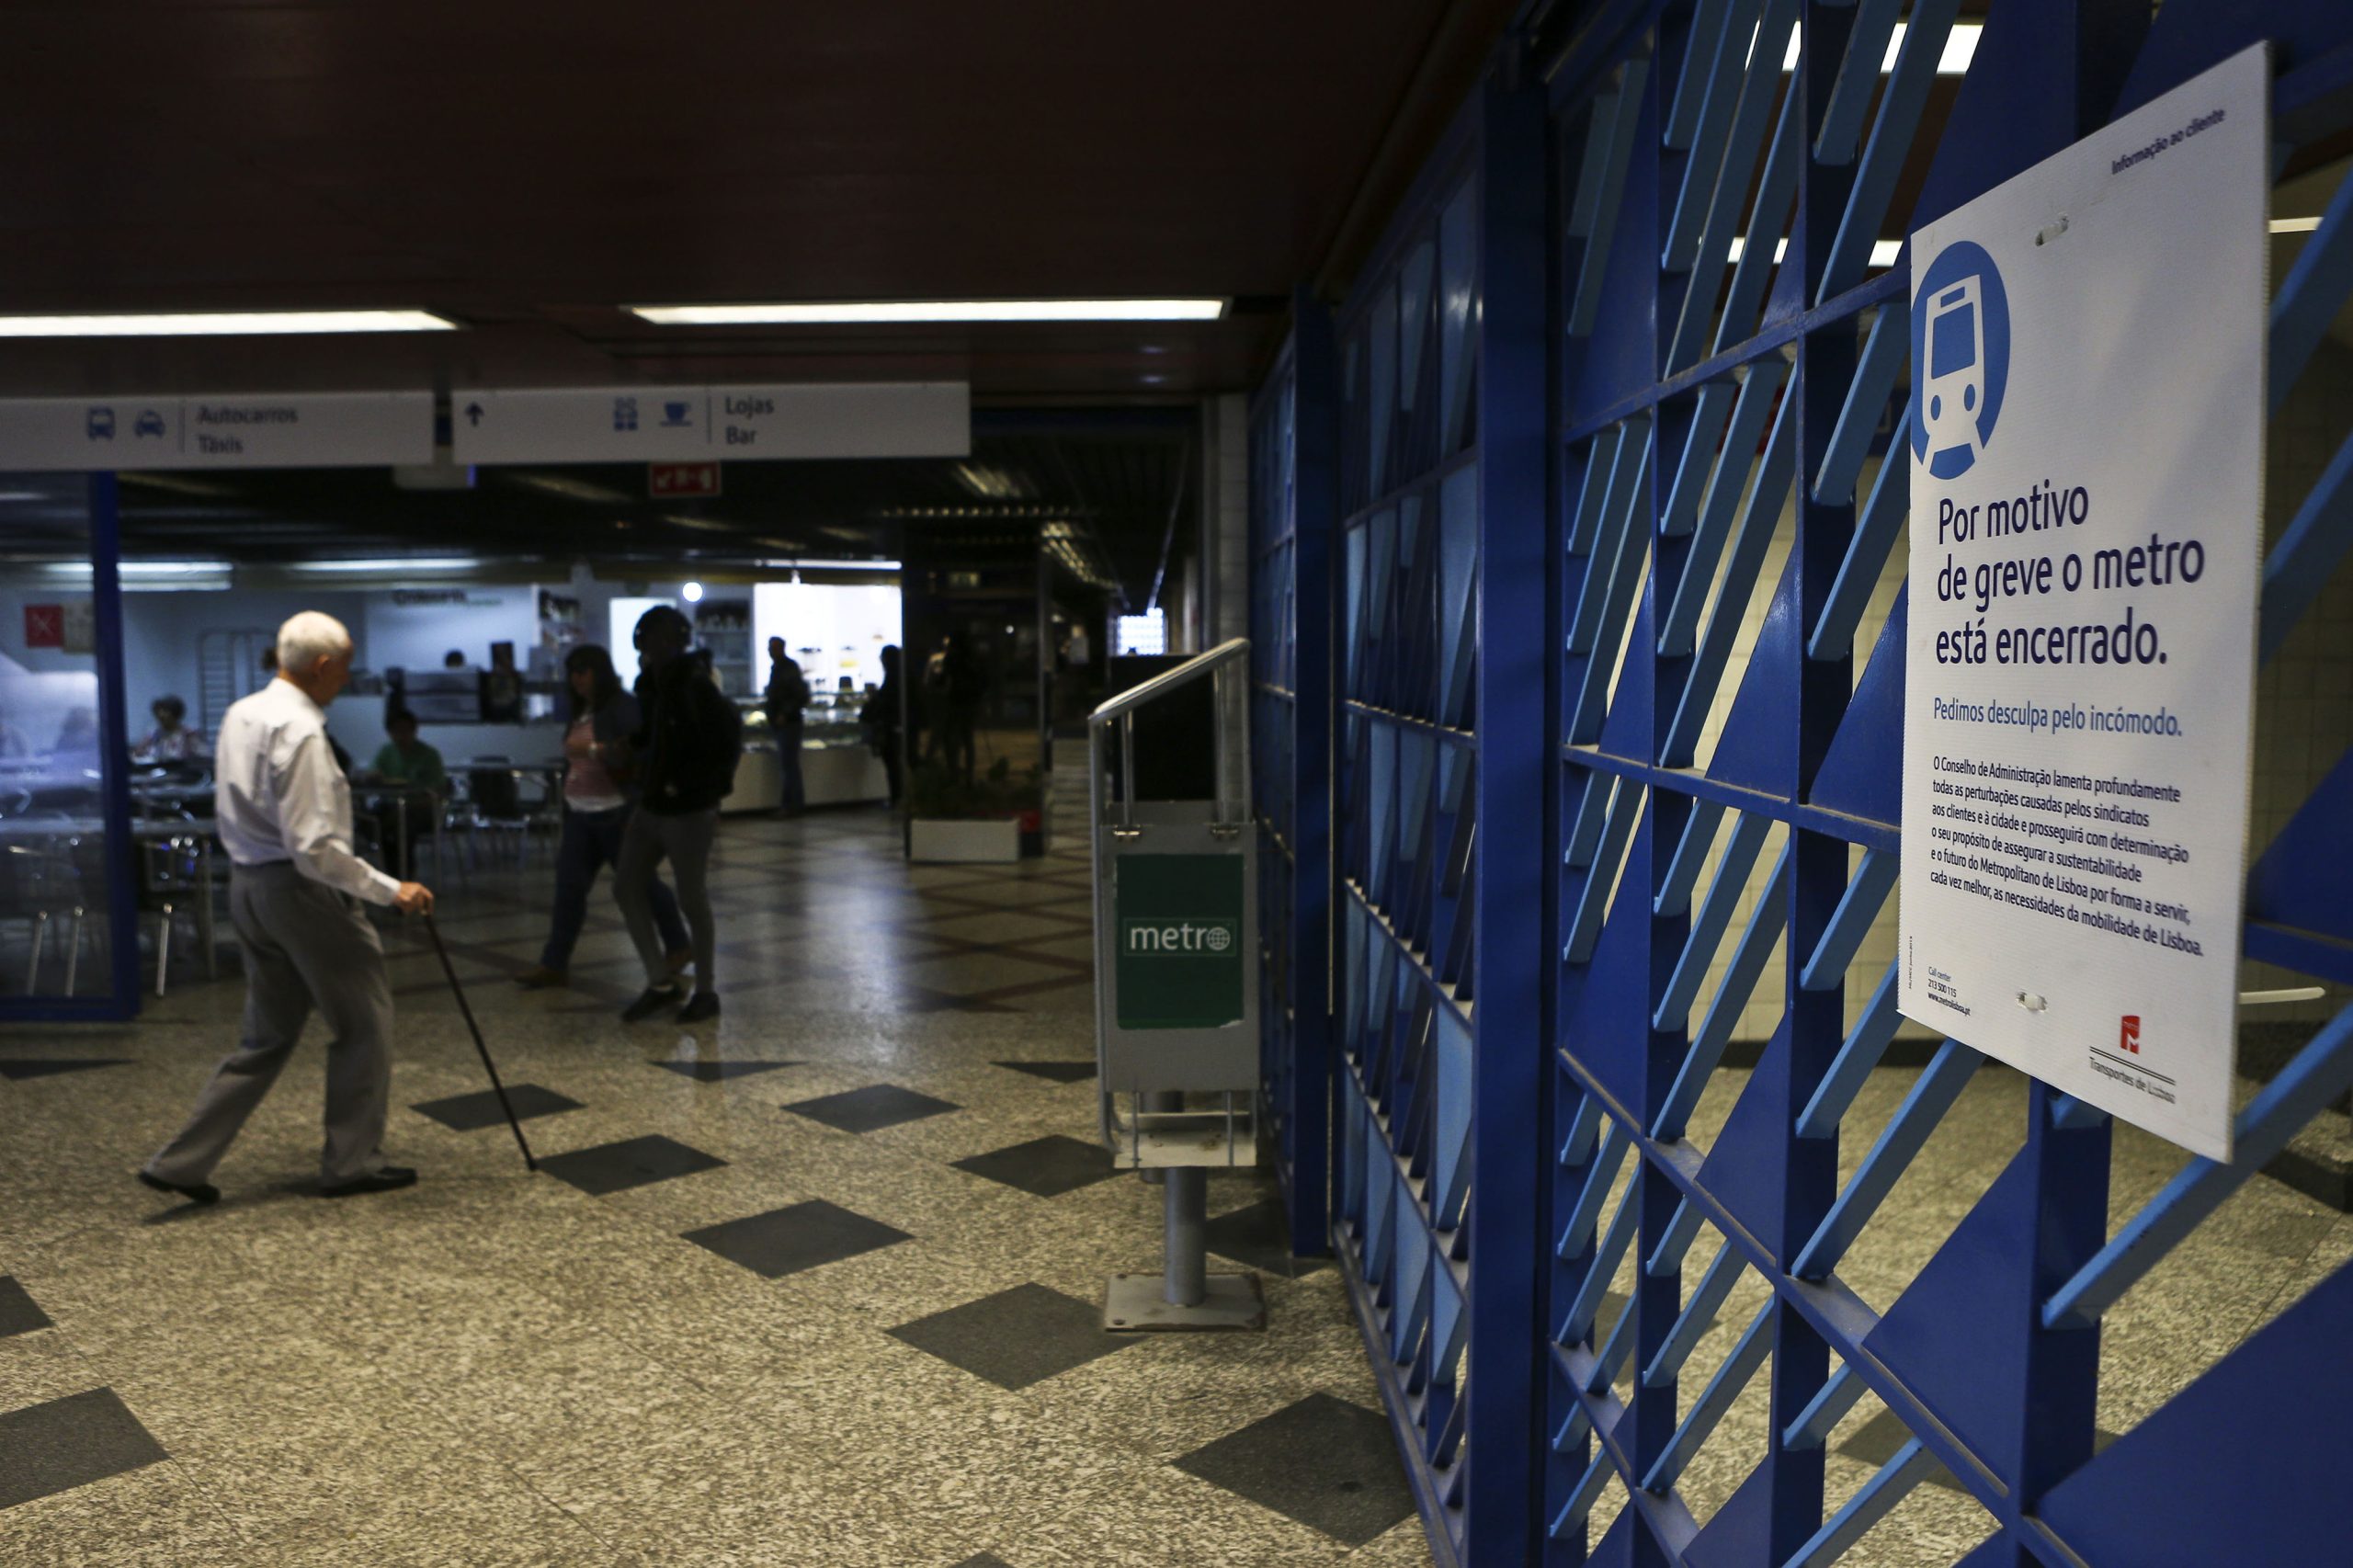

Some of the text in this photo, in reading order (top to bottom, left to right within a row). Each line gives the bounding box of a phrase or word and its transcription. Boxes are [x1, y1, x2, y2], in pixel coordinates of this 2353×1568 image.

[2112, 109, 2224, 175] Informação ao cliente
[197, 405, 299, 424] Autocarros
[725, 396, 775, 421] Lojas
[725, 426, 757, 445] Bar
[1938, 478, 2089, 545] Por motivo
[1937, 532, 2205, 613] de greve o metro
[1936, 606, 2167, 665] está encerrado.
[1934, 697, 2183, 736] Pedimos desculpa pelo incómodo.
[1933, 779, 2150, 827] todas as perturbações causadas pelos sindicatos
[1934, 756, 2181, 802] O Conselho de Administração lamenta profundamente
[1932, 803, 2189, 865] aos clientes e à cidade e prosseguirá com determinação
[1932, 827, 2143, 882] o seu propósito de assegurar a sustentabilidade
[1930, 870, 2204, 957] cada vez melhor, as necessidades da mobilidade de Lisboa.
[1931, 848, 2191, 926] e o futuro do Metropolitano de Lisboa por forma a servir,
[1928, 978, 1957, 997] 213 500 115
